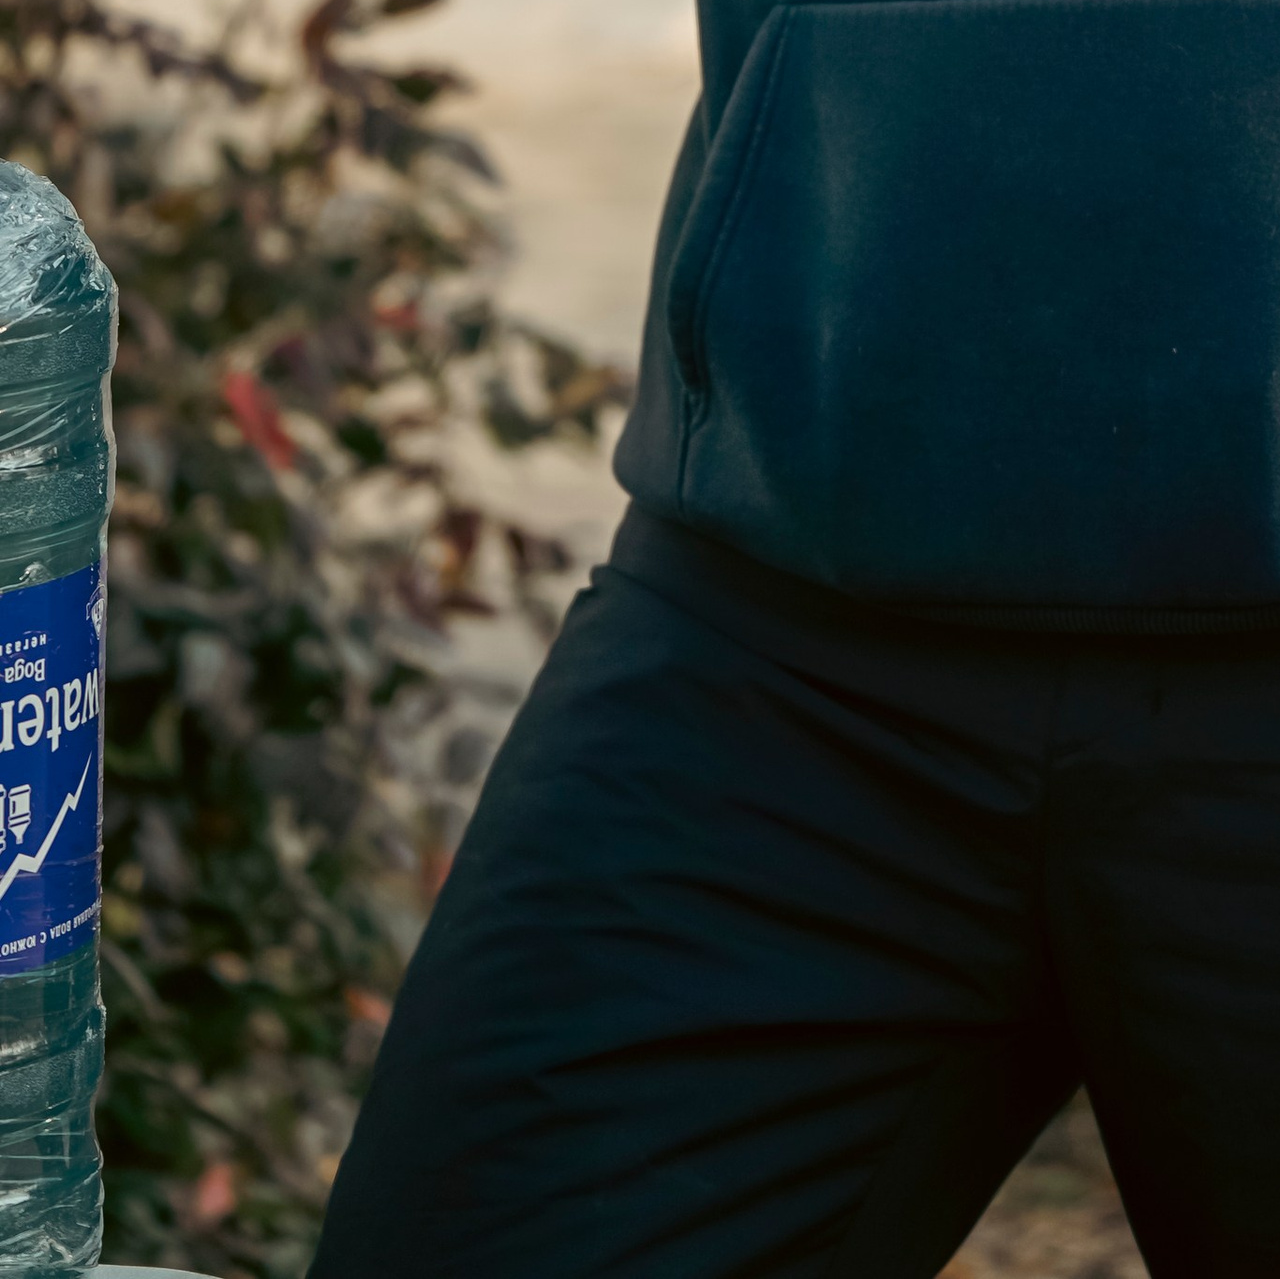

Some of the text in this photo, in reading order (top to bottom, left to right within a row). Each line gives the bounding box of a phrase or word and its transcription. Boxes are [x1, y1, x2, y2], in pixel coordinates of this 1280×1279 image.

[0, 633, 46, 656] негаз
[50, 920, 71, 939] ВОДА
[0, 935, 36, 957] ЮЖНО
